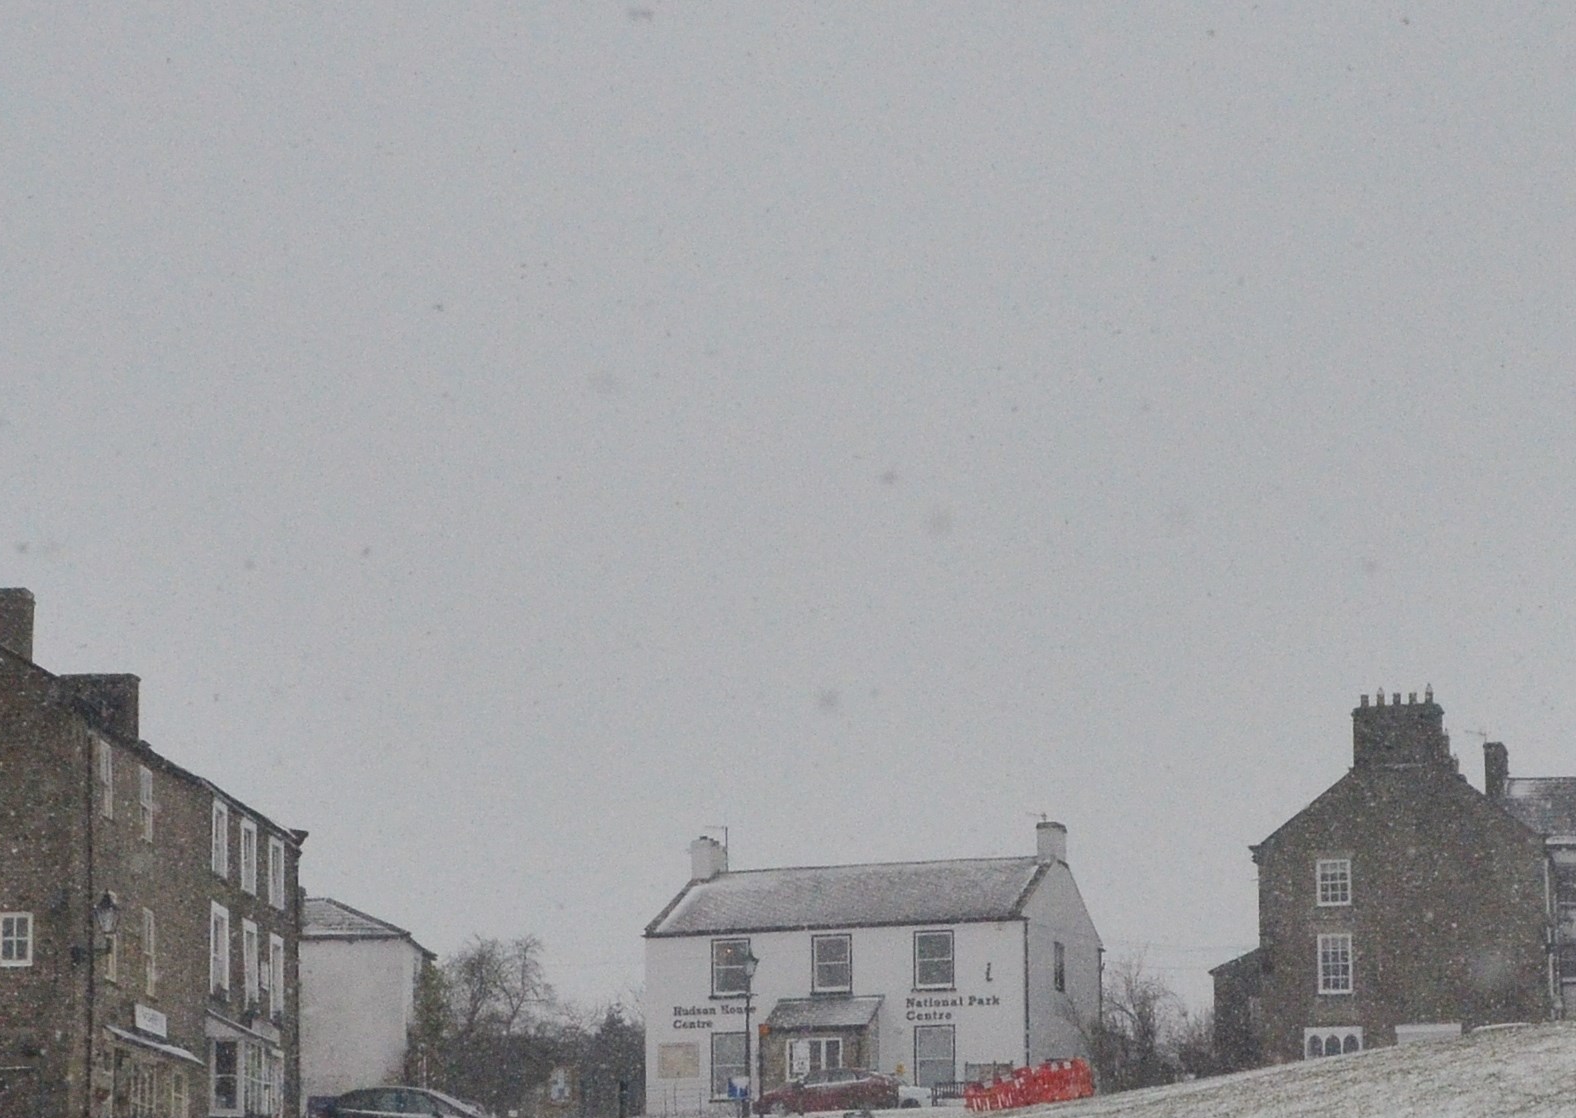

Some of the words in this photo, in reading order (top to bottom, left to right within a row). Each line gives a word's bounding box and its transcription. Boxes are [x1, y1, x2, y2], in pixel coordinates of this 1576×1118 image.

[905, 996, 964, 1008] National
[968, 995, 1001, 1006] Park
[672, 1006, 717, 1017] Hudson
[905, 1010, 953, 1021] Centre
[672, 1019, 714, 1029] Centre
